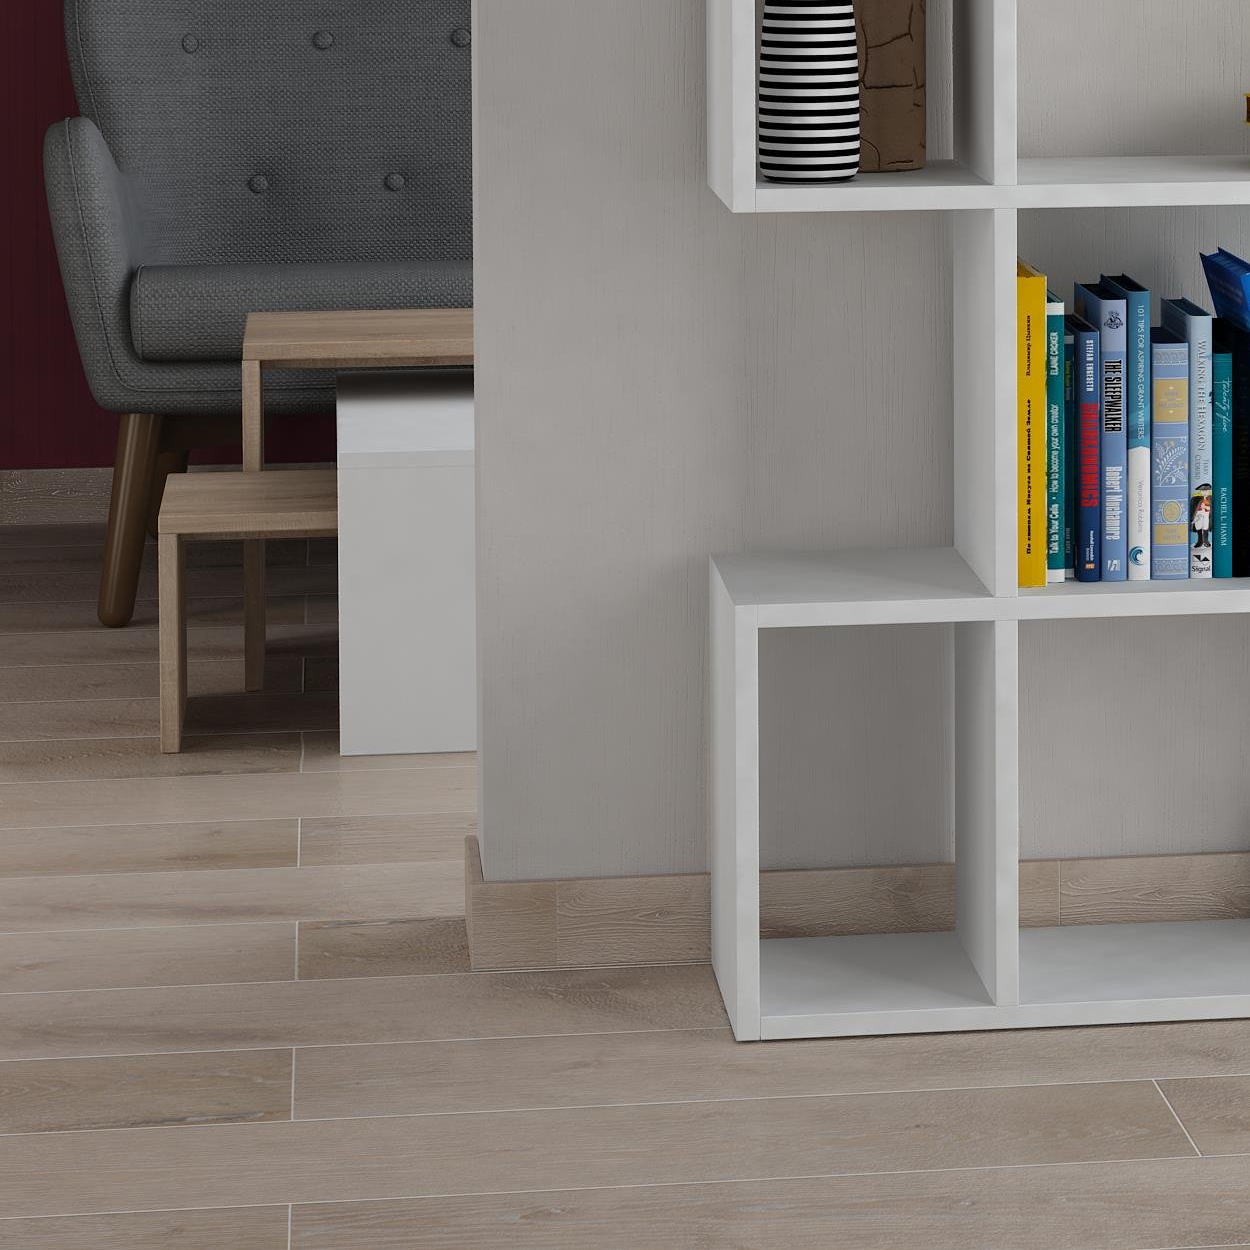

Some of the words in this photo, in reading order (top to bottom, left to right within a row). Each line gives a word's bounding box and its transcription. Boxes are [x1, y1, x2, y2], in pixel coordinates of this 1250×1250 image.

[1086, 340, 1094, 361] STEFAN
[1104, 359, 1122, 374] THE
[1198, 340, 1207, 383] WALKING
[1104, 376, 1122, 432] SLEEPWALKER
[1198, 387, 1207, 404] THE
[1198, 407, 1207, 450] HEXAGON
[1051, 437, 1060, 450] your
[1050, 450, 1058, 472] become
[1081, 403, 1099, 507] SHARKONOMICS
[1050, 480, 1058, 492] How
[1105, 466, 1123, 492] Robert
[1050, 504, 1058, 518] Cells
[1105, 494, 1123, 540] Muchamore
[1050, 521, 1058, 533] Your
[1050, 542, 1058, 554] Talk
